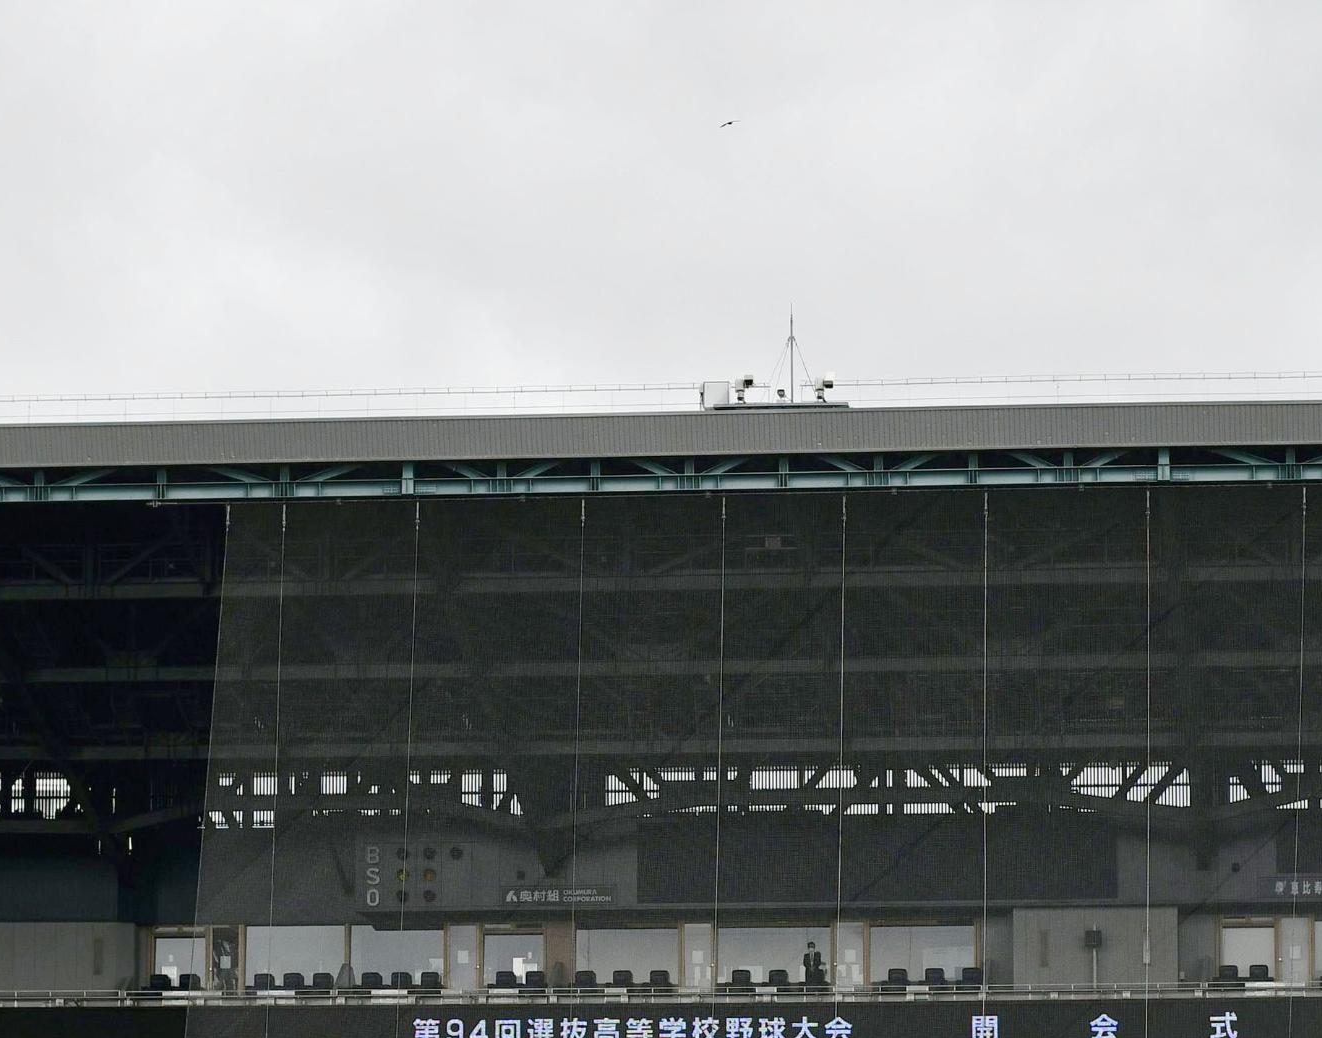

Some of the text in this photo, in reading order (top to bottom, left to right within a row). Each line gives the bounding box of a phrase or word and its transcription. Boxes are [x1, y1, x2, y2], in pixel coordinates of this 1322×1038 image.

[366, 868, 381, 886] S
[519, 890, 559, 902] 奥村組
